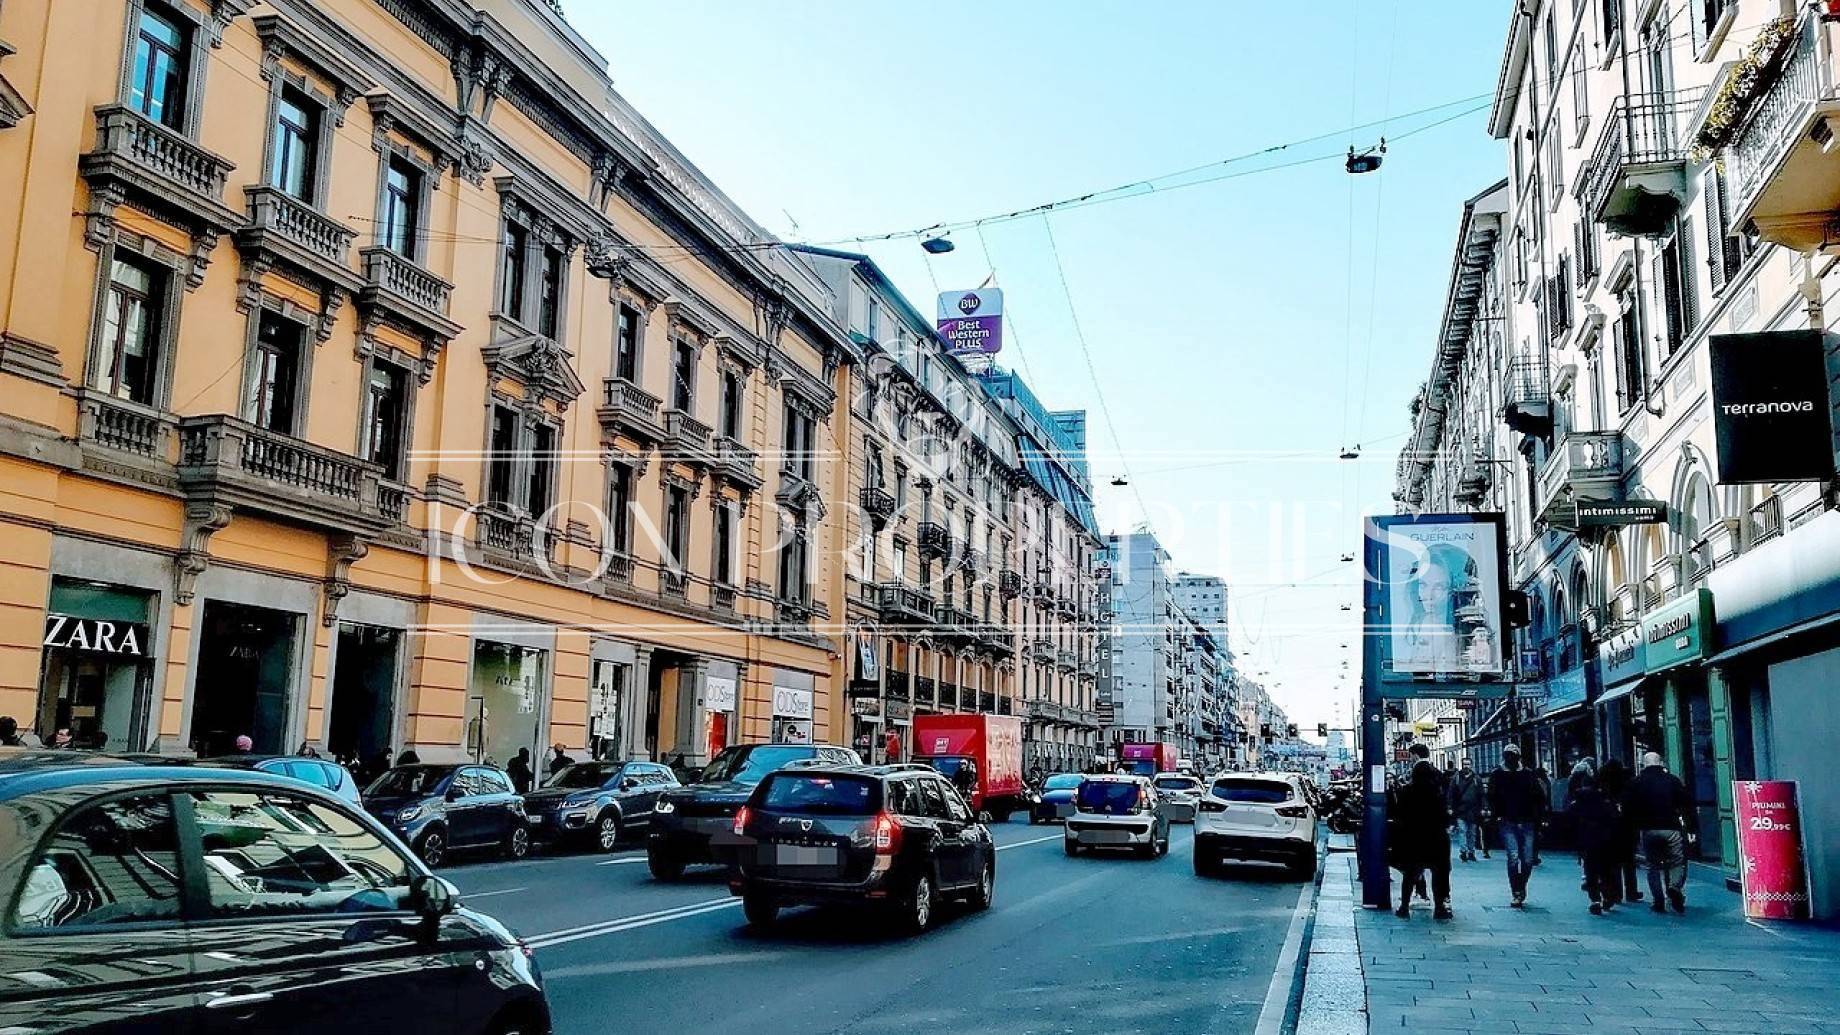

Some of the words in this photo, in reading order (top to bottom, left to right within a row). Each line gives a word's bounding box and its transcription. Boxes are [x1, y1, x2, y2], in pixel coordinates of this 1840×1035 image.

[961, 298, 978, 309] BW
[958, 320, 980, 329] Best
[948, 329, 990, 339] Western
[955, 338, 983, 349] PLUS
[1579, 507, 1657, 516] intimissimi
[1410, 531, 1475, 542] GUERLAIN
[43, 615, 142, 656] ZARA
